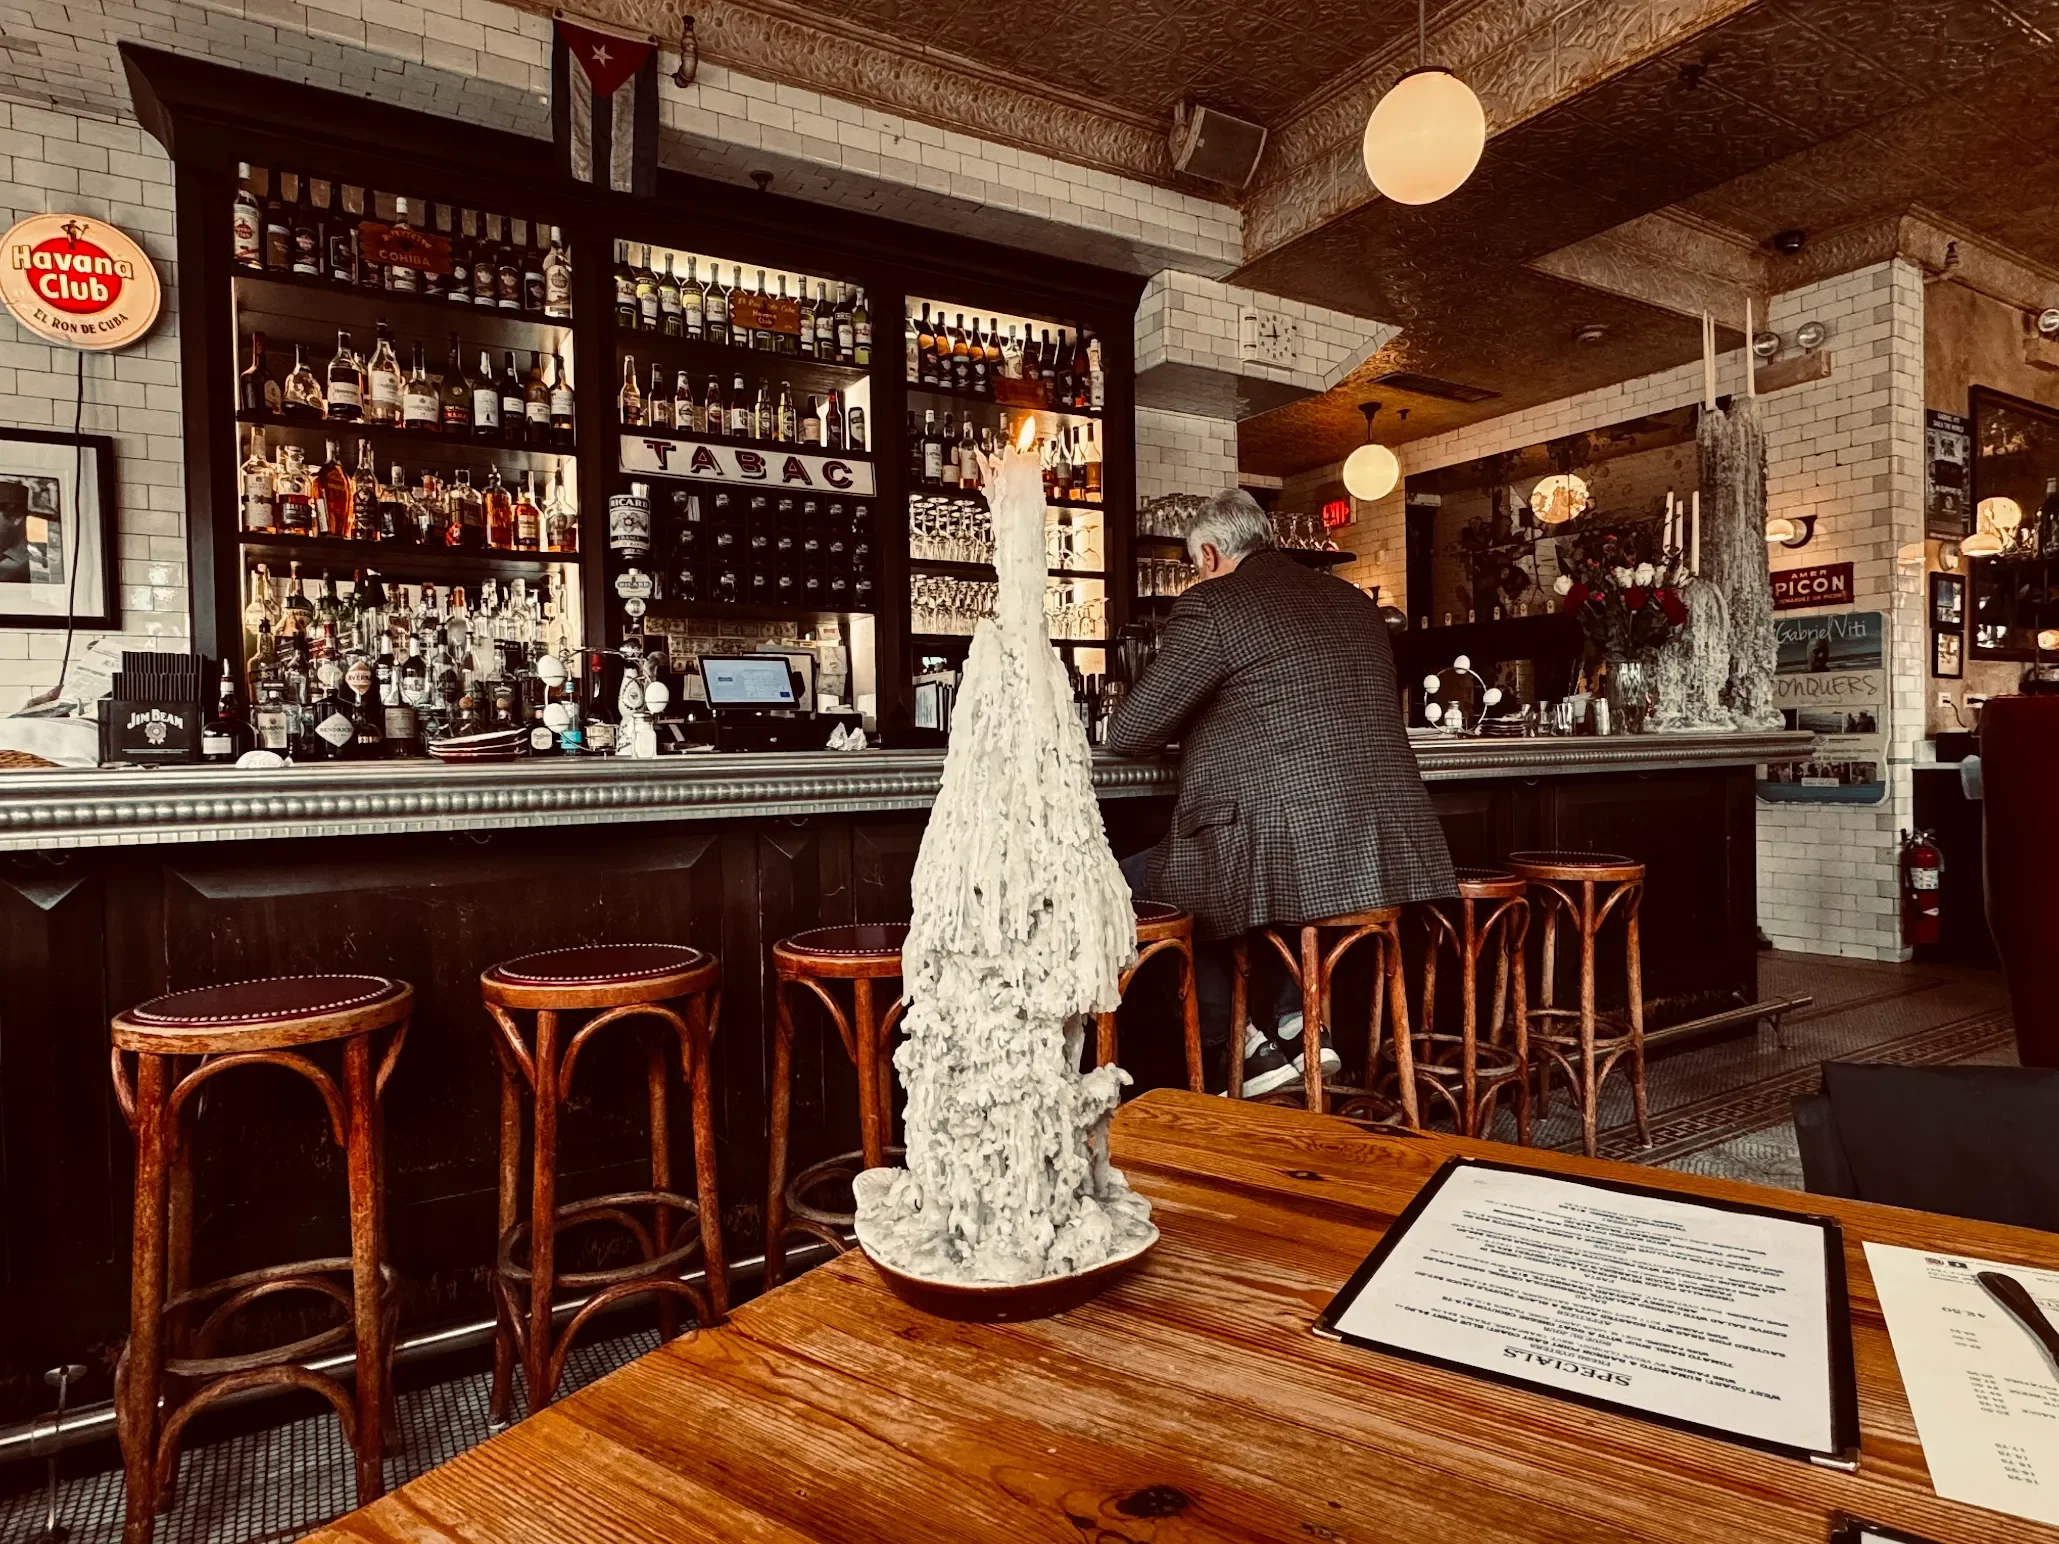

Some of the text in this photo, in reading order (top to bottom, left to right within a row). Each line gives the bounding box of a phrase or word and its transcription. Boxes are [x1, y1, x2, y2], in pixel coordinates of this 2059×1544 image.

[12, 245, 134, 280] Havana
[379, 249, 431, 267] COHIBA
[39, 273, 109, 302] Club
[33, 308, 129, 334] EL RON DE CUBA
[643, 439, 853, 489] TABAC
[610, 498, 649, 509] RICARD
[1775, 574, 1845, 597] PICON
[1791, 569, 1827, 580] AMER
[1775, 615, 1867, 645] Gabriel Viti
[127, 708, 184, 730] JIM BEAM
[1503, 1348, 1632, 1387] SPECIALS
